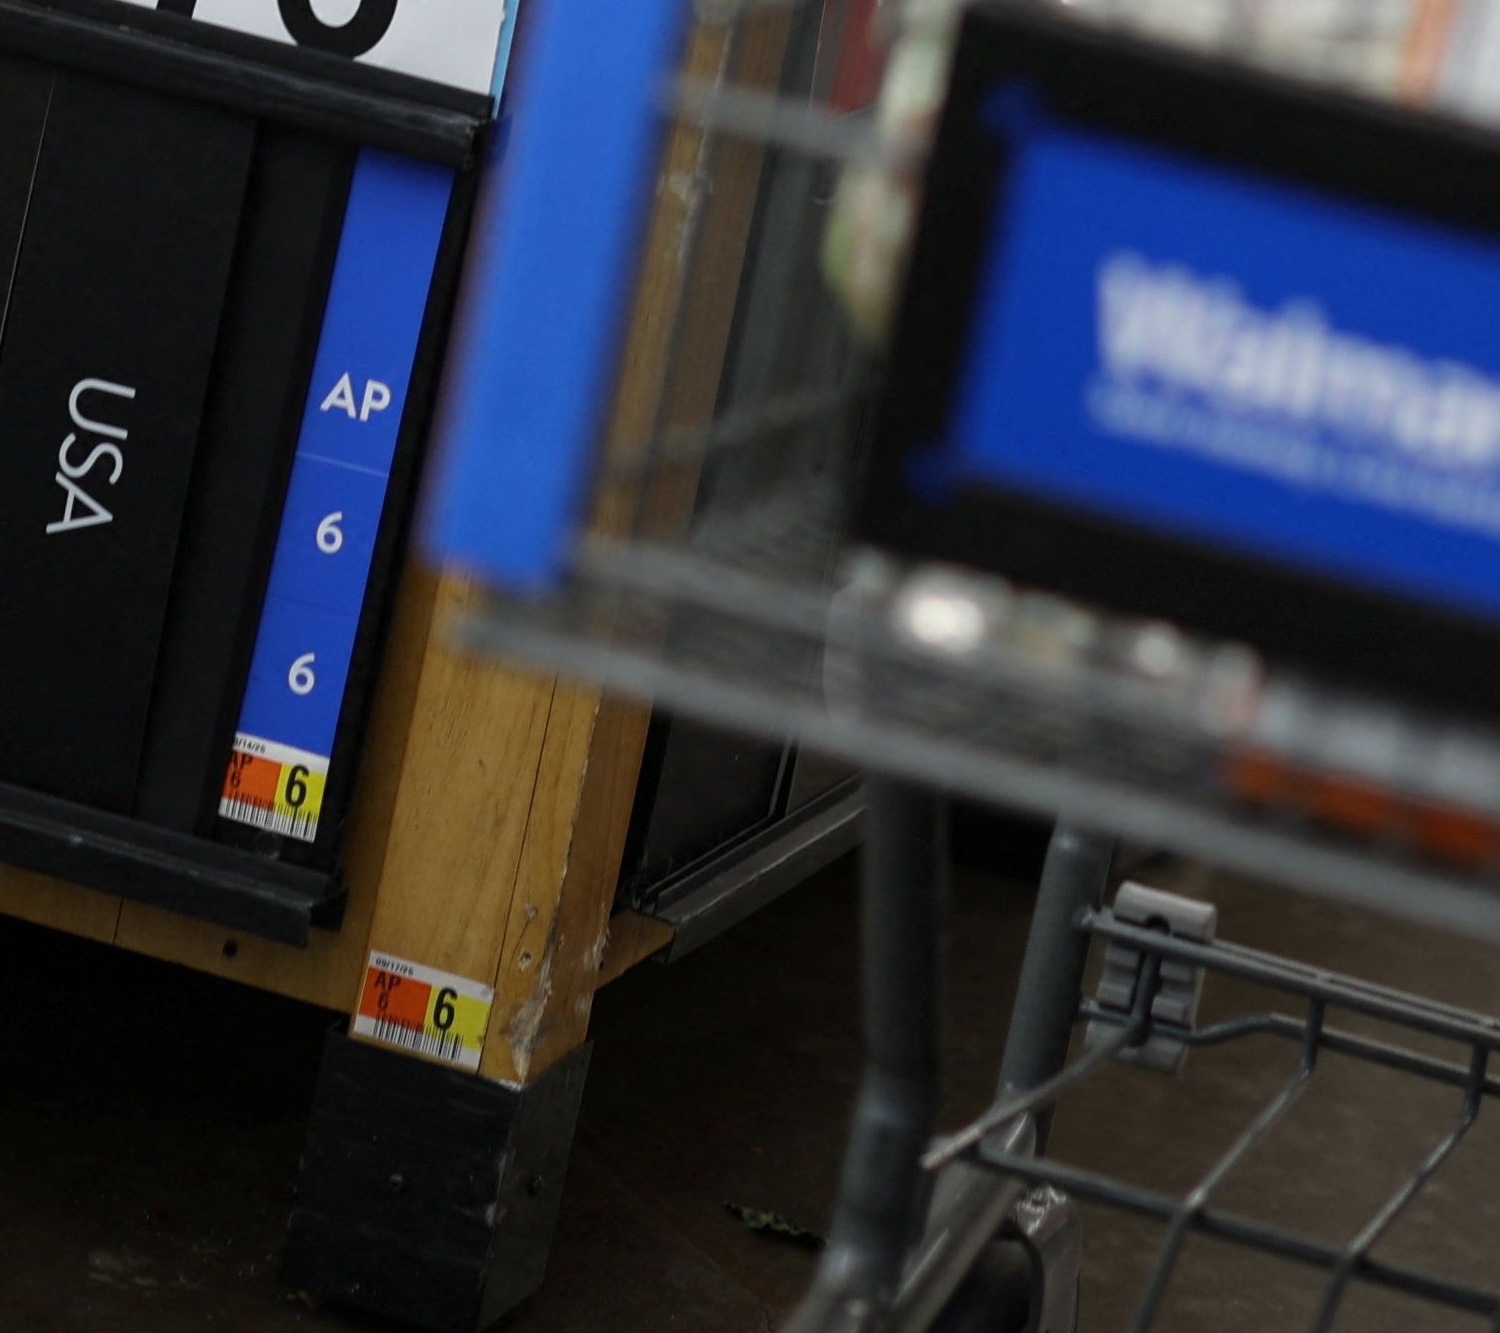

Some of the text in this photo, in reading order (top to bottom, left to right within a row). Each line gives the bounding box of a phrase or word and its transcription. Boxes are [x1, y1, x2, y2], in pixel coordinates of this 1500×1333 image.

[318, 371, 392, 423] AP
[43, 376, 136, 535] USA
[315, 509, 344, 555] 6
[287, 651, 315, 698] 6
[285, 764, 310, 807] 6
[374, 971, 401, 990] AP
[433, 987, 458, 1030] 6
